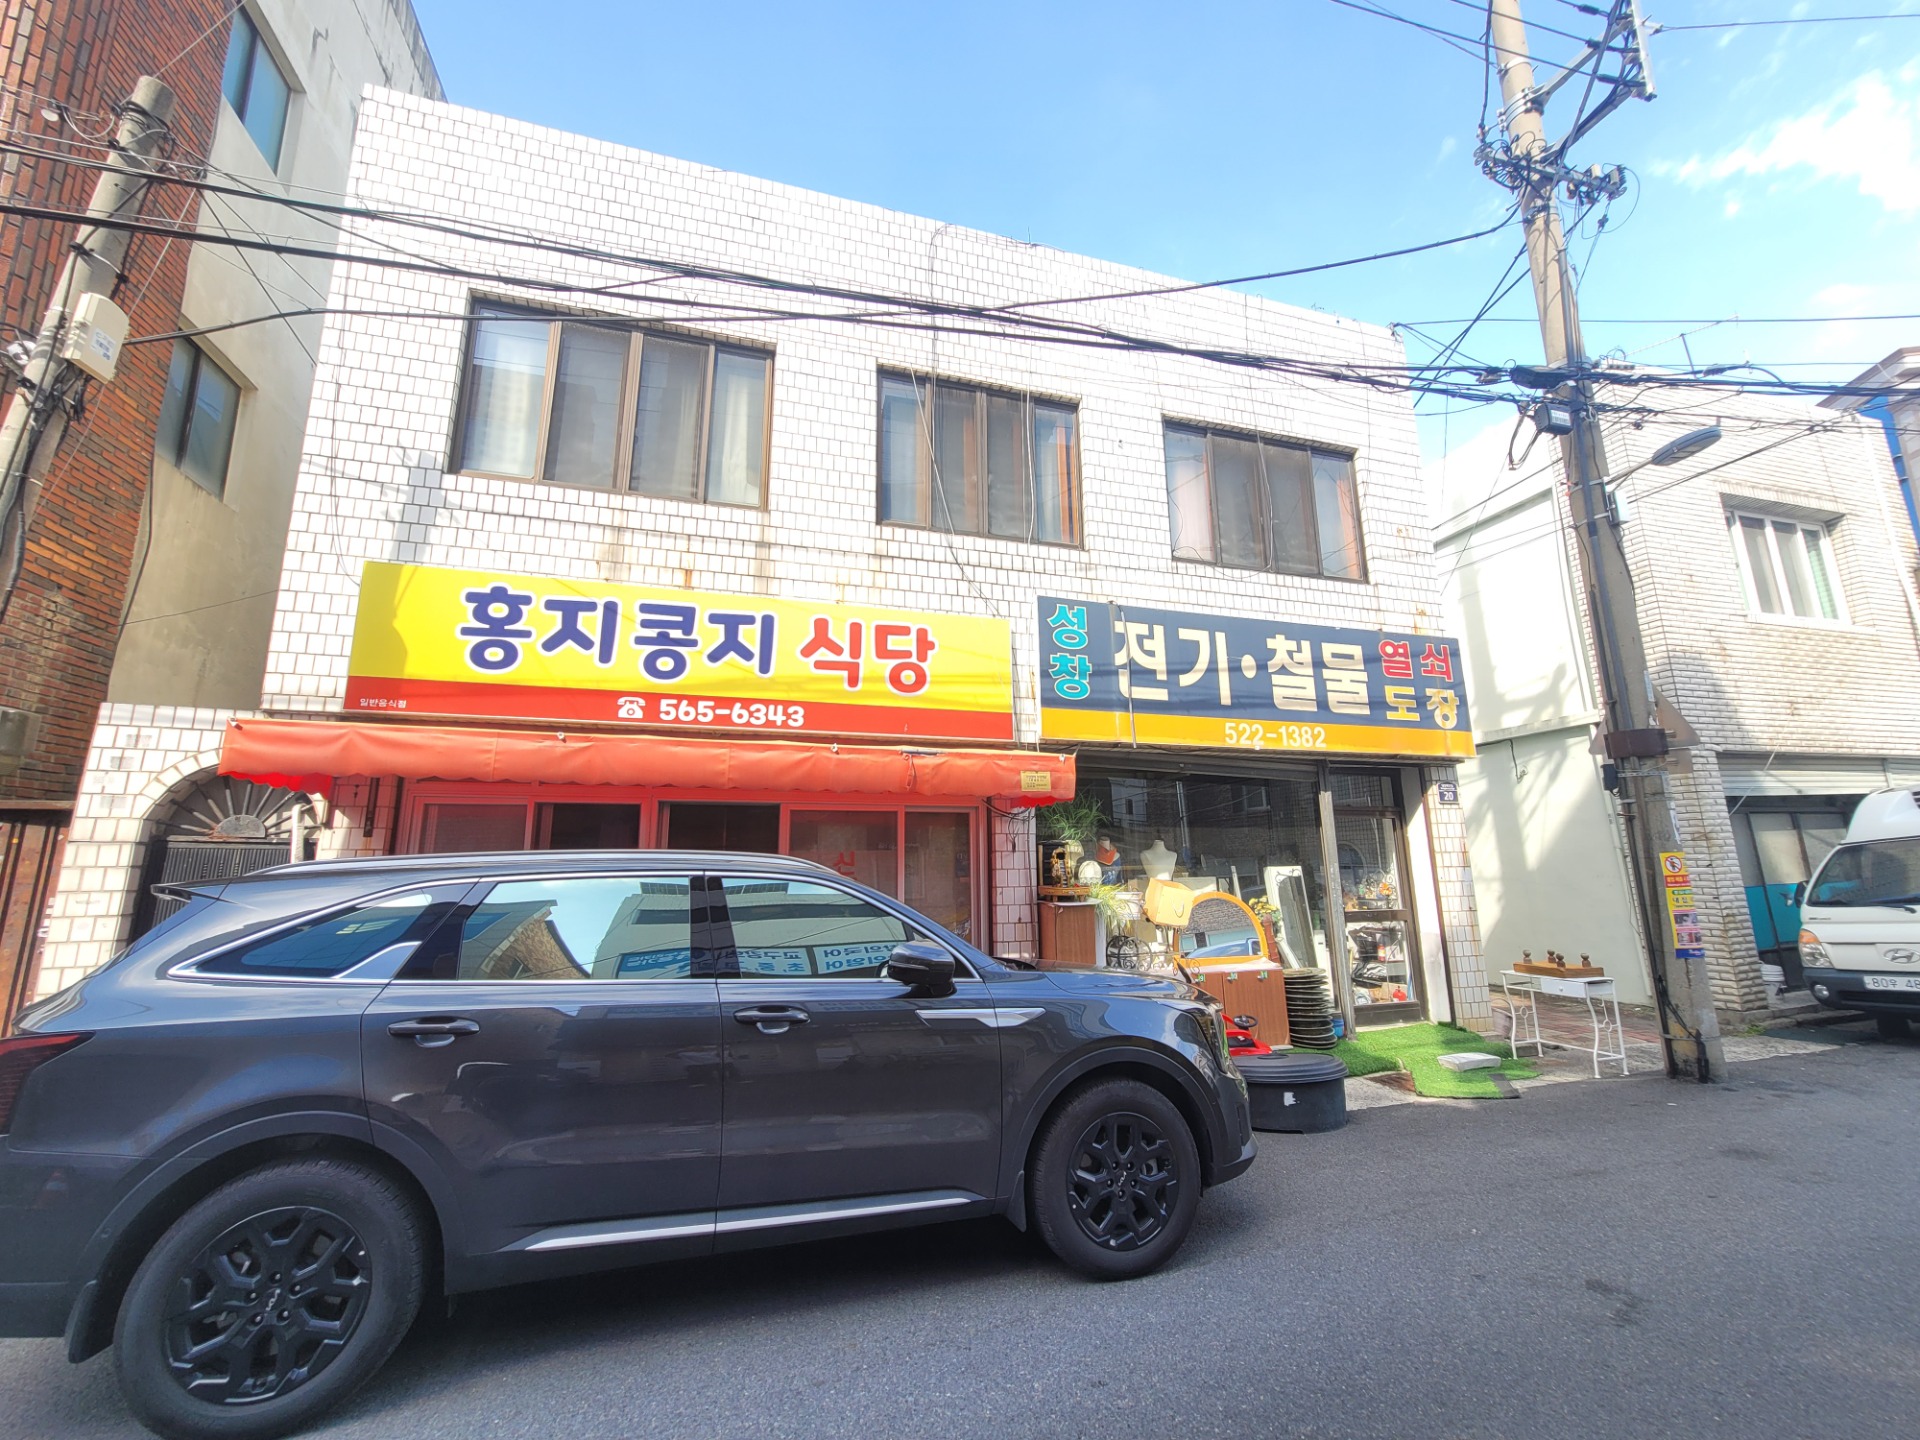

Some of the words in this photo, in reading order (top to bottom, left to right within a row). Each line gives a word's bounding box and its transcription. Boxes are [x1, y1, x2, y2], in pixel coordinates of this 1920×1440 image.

[458, 584, 777, 682] 홍지콩지
[798, 616, 937, 695] 식당
[1046, 603, 1093, 700] 성창
[1378, 639, 1454, 682] 열쇠
[359, 698, 407, 709] 일반음식점
[659, 698, 806, 728] 565-6343
[1384, 685, 1460, 730] 도장
[1224, 722, 1327, 749] 522-1382
[1443, 791, 1455, 801] 20
[1871, 977, 1898, 989] 80우
